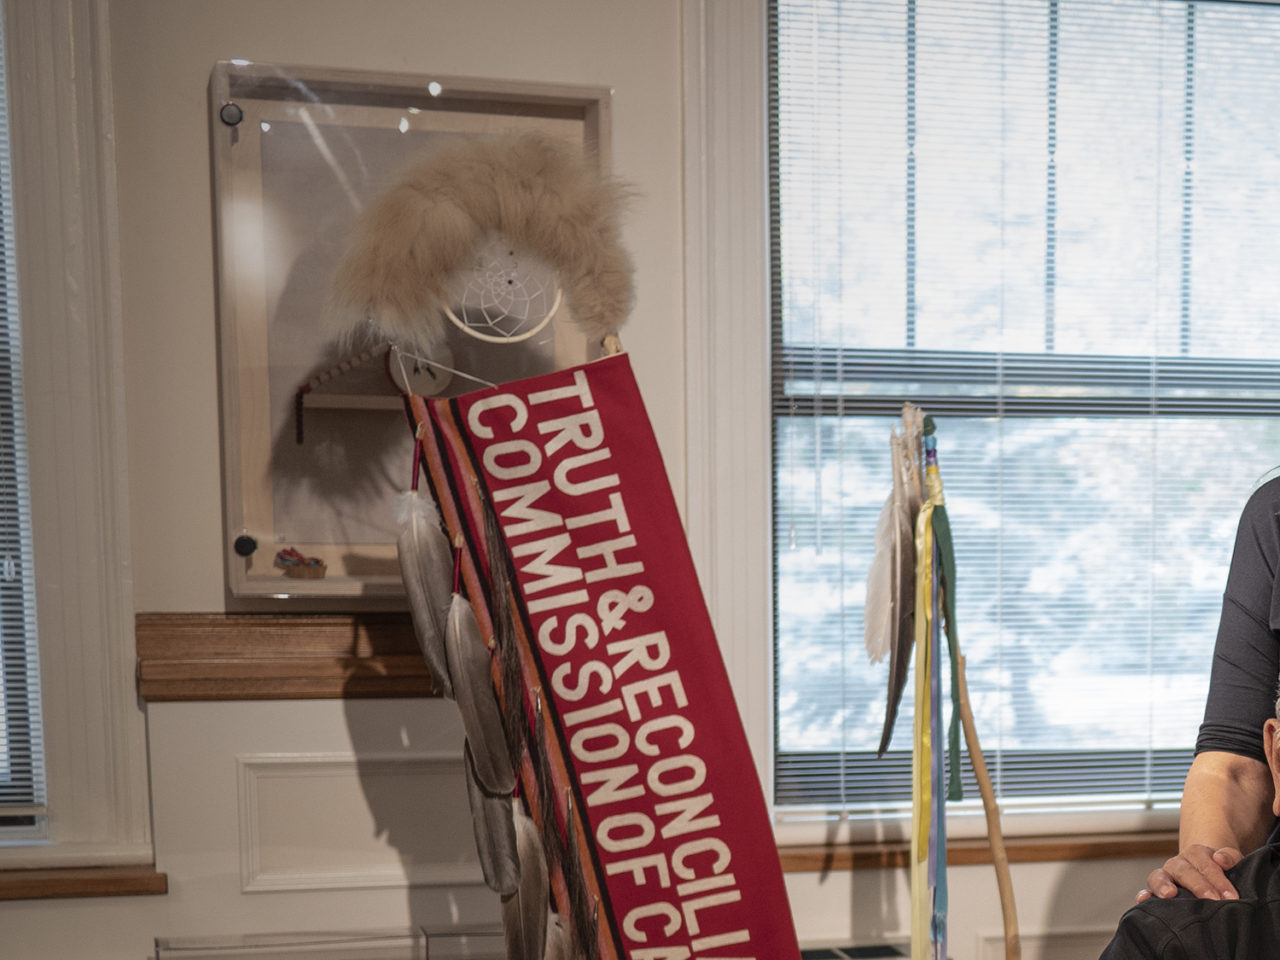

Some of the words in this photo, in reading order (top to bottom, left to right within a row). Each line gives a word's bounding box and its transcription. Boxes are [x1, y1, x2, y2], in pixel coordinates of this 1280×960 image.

[467, 393, 646, 807] COMMISSION
[596, 812, 671, 888] OF
[528, 370, 645, 584] TRUTH
[596, 585, 655, 637] &
